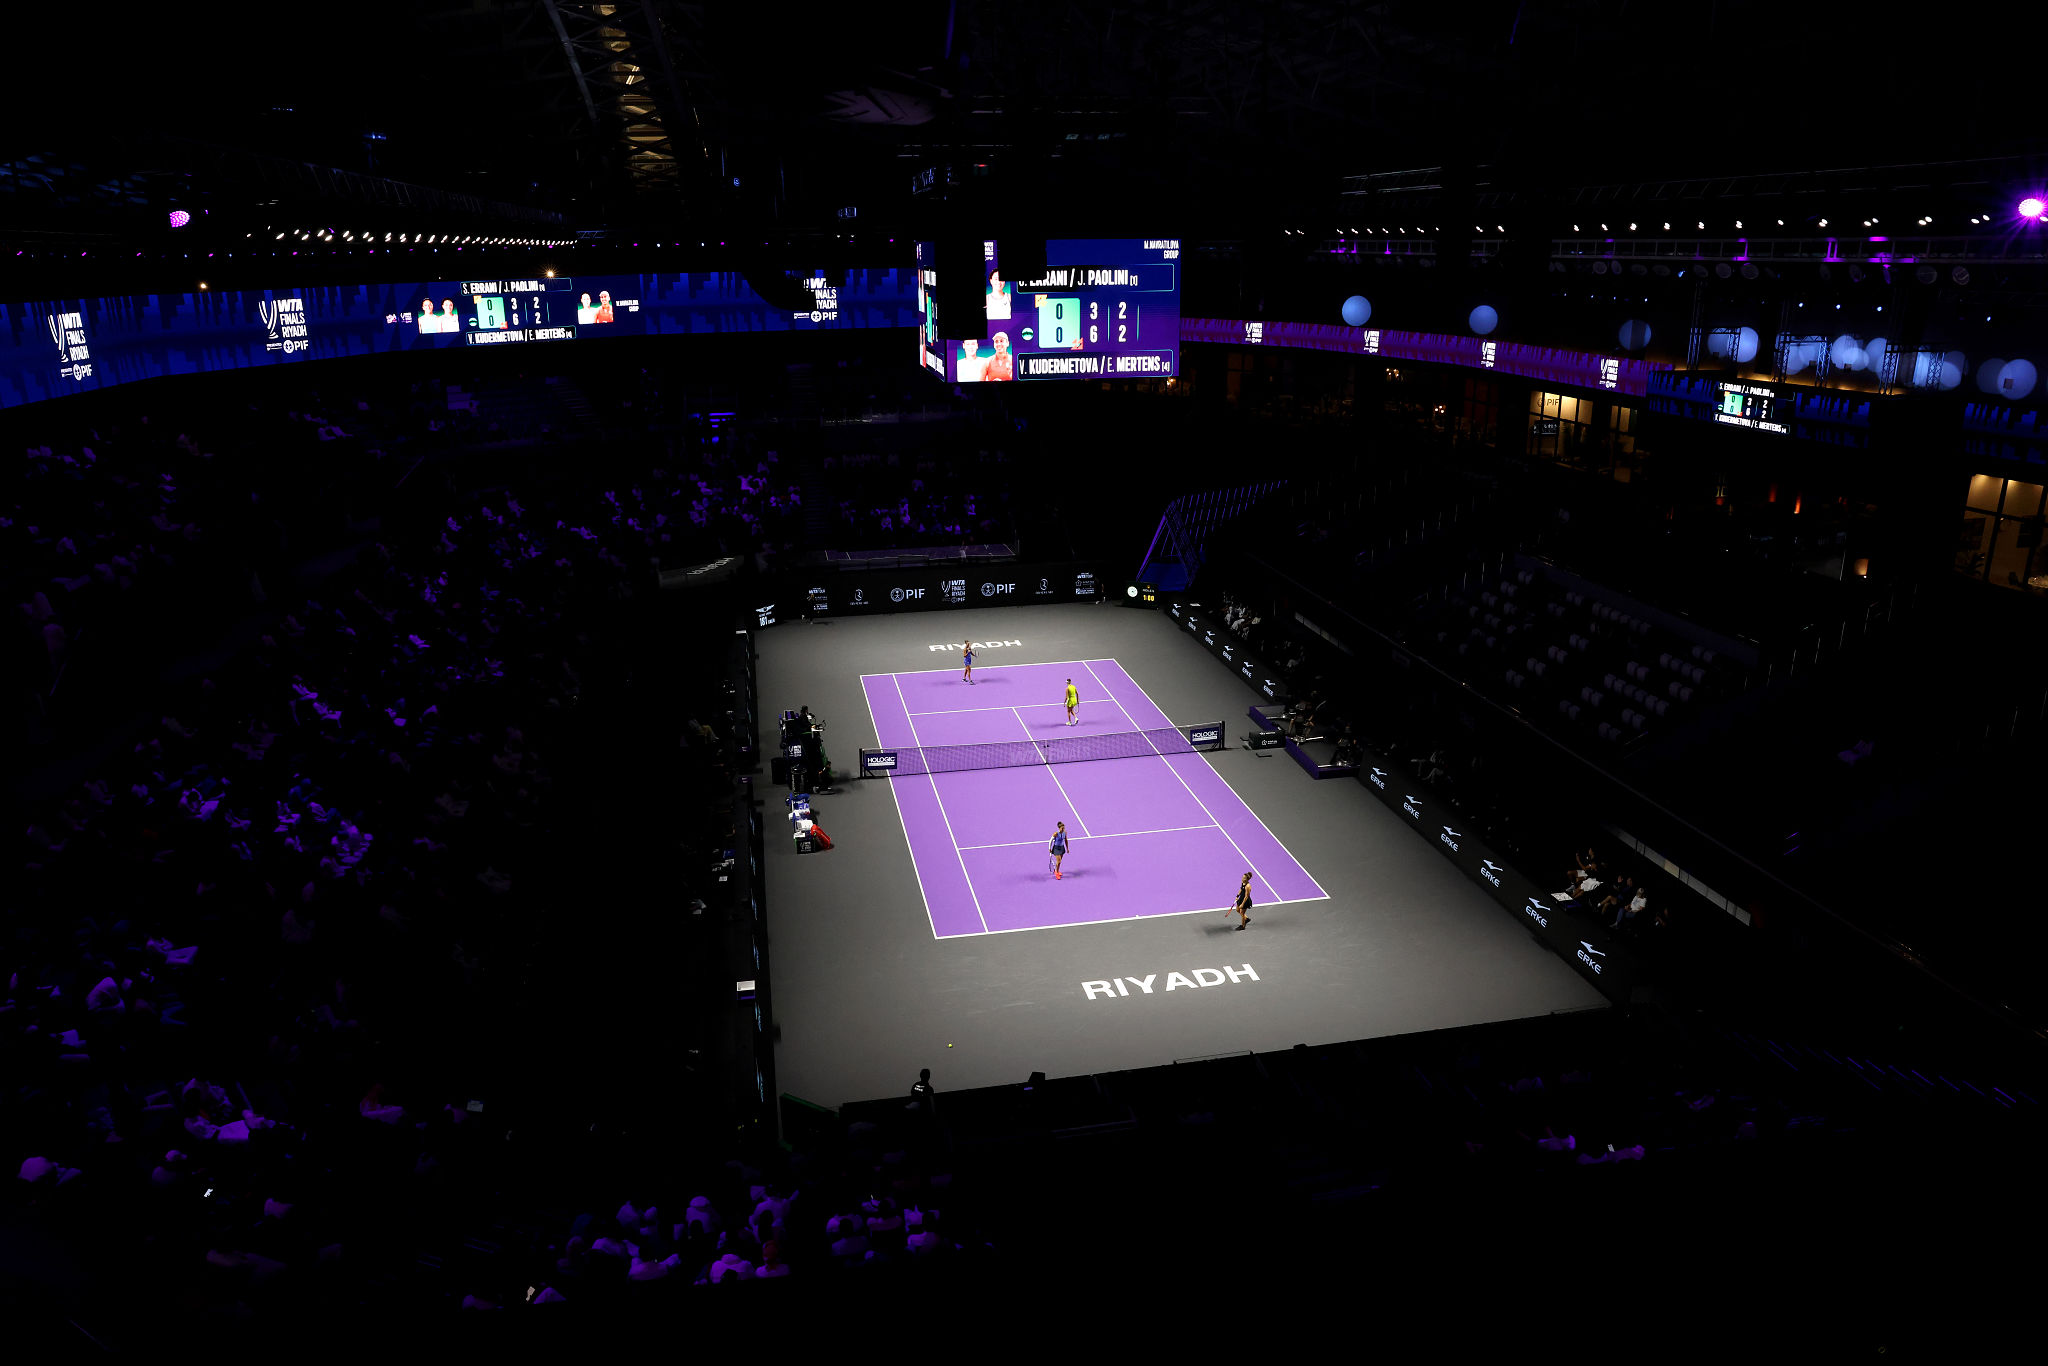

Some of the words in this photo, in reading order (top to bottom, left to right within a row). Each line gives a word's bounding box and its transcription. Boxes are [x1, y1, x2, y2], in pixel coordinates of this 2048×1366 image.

[1164, 250, 1179, 259] GROUP
[1078, 270, 1086, 286] J.
[1088, 270, 1128, 286] PAOLINI
[462, 284, 470, 294] S.
[470, 282, 498, 294] ERRANI
[504, 282, 510, 292] J.
[511, 281, 538, 292] PAOLINI
[811, 289, 836, 299] INALS
[277, 298, 303, 312] WTA
[487, 299, 492, 310] 0
[511, 298, 517, 310] 3
[533, 297, 540, 308] 2
[816, 300, 838, 310] IYADH
[822, 312, 838, 320] PIF
[1056, 303, 1063, 320] 0
[1090, 302, 1098, 320] 3
[1119, 301, 1126, 320] 2
[62, 312, 82, 329] WTA
[280, 312, 305, 325] FINALS
[489, 315, 494, 326] 0
[513, 313, 519, 325] 6
[534, 312, 541, 324] 2
[282, 325, 307, 338] RIYADH
[468, 333, 474, 344] V.
[475, 330, 524, 344] KUDERMETOVA
[529, 329, 535, 340] E.
[535, 328, 566, 339] MERTENS
[1056, 326, 1063, 343] 0
[1090, 325, 1098, 343] 6
[1119, 324, 1126, 342] 2
[294, 340, 308, 350] PIF
[81, 364, 92, 377] PIF
[1019, 359, 1027, 375] V.
[1029, 357, 1098, 375] KUDERMETOVA
[1107, 357, 1114, 372] E.
[1117, 356, 1160, 372] MERTENS
[1763, 400, 1768, 408] 2
[1762, 410, 1766, 418] 2
[906, 589, 925, 599] PIF
[997, 584, 1015, 594] PIF
[928, 640, 1022, 651] RIYADH
[1370, 774, 1385, 790] ERKE
[1404, 802, 1419, 819] ERKE
[1441, 833, 1458, 852] ERKE
[1480, 867, 1500, 888] ERKE
[1526, 905, 1548, 928] ERKE
[1577, 950, 1602, 974] ERKE
[1081, 963, 1260, 1000] RIYADH
